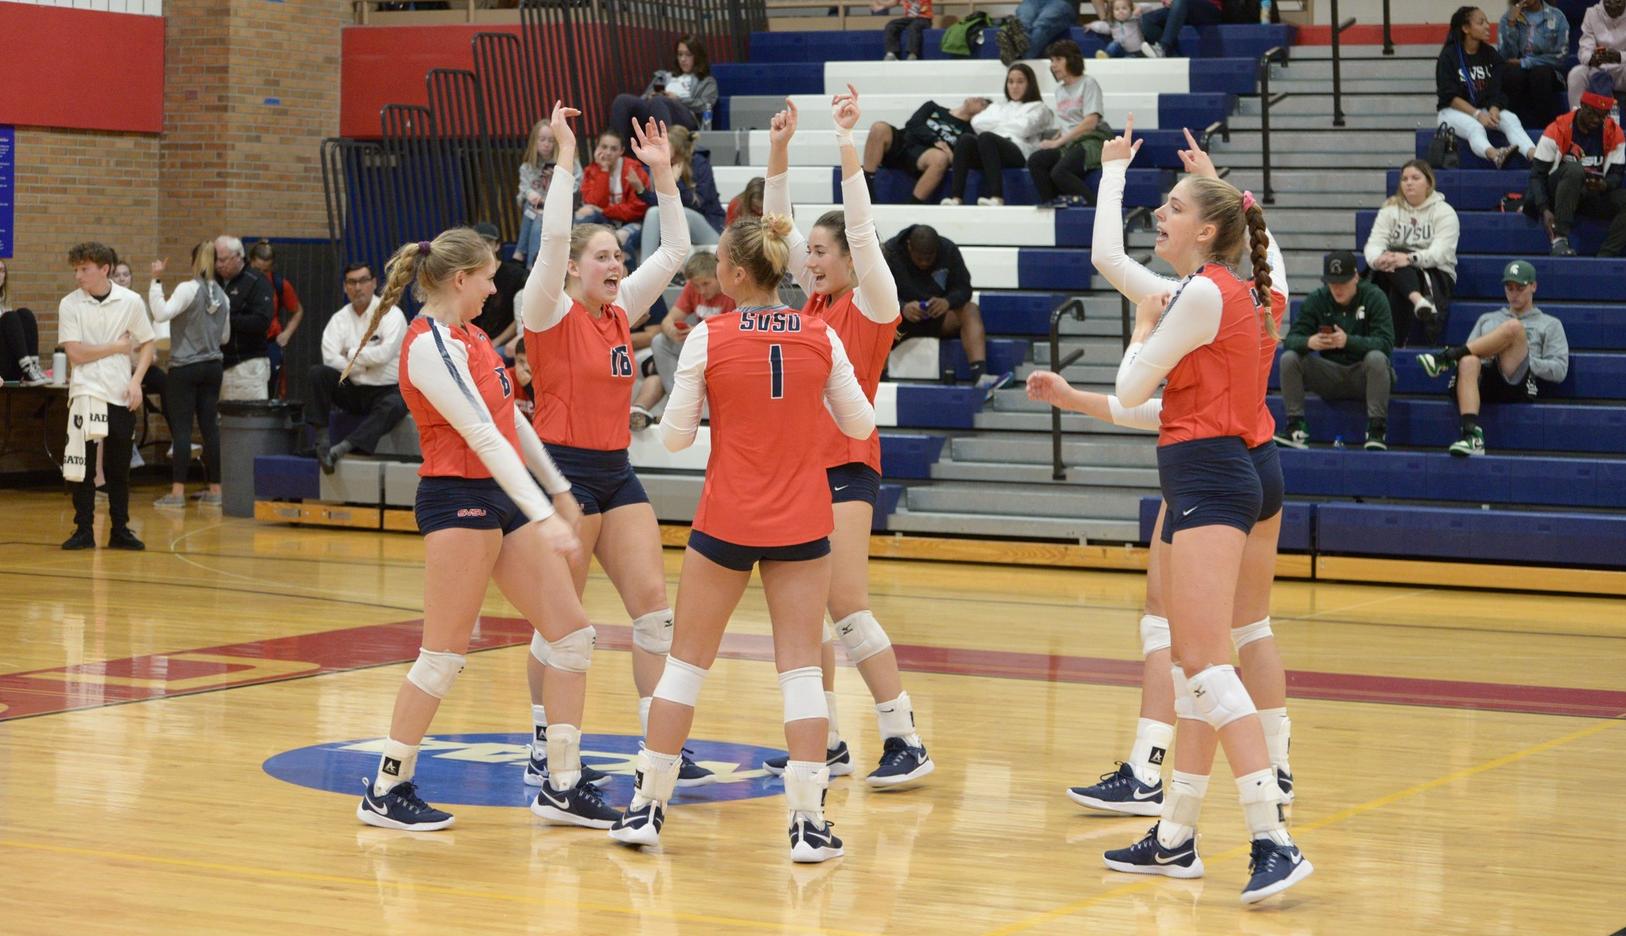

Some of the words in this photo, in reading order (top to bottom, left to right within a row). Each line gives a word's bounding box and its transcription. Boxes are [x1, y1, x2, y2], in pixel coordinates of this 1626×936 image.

[1389, 223, 1431, 243] SVSU
[739, 311, 801, 332] SVSU
[610, 344, 633, 377] 16
[769, 344, 783, 399] 1
